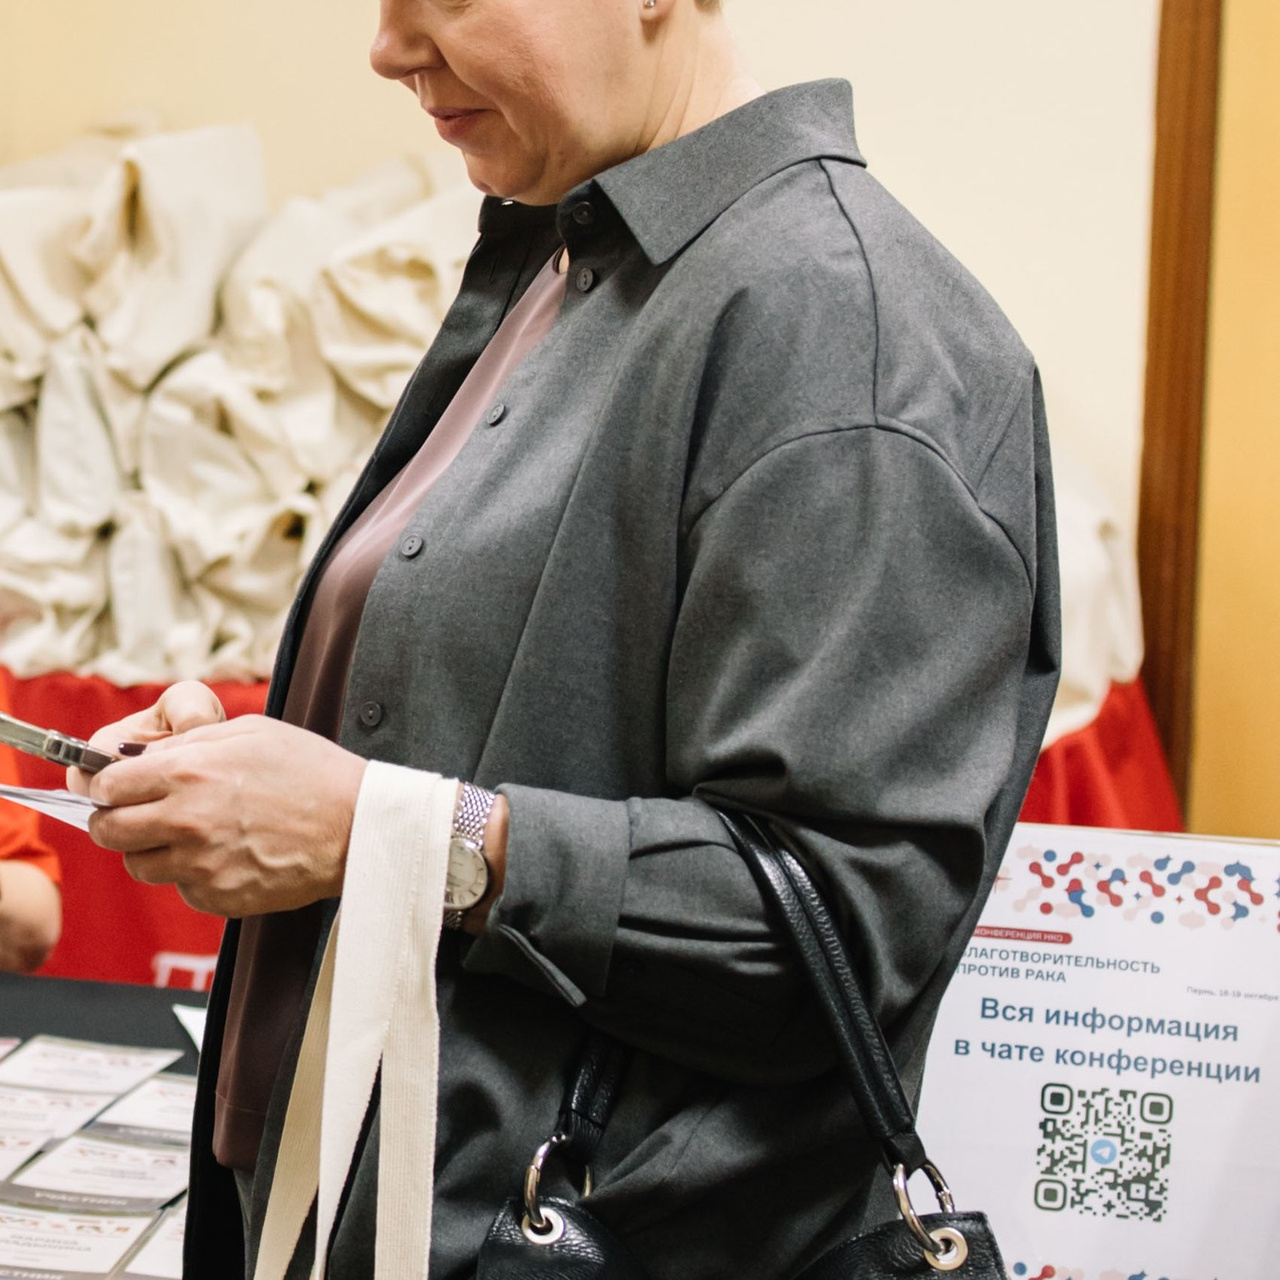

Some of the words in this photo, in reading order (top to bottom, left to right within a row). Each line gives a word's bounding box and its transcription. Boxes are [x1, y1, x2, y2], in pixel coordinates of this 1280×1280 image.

[956, 962, 1021, 979] ПРОТИВ
[1025, 968, 1066, 983] РАКА
[962, 946, 1161, 974] ЛАГОТВОРИТЕЛЬНОСТЬ
[980, 997, 1034, 1023] Вся
[1044, 1006, 1239, 1042] информация
[954, 1039, 970, 1056] в
[981, 1041, 1045, 1062] чате
[1055, 1048, 1261, 1083] конференции
